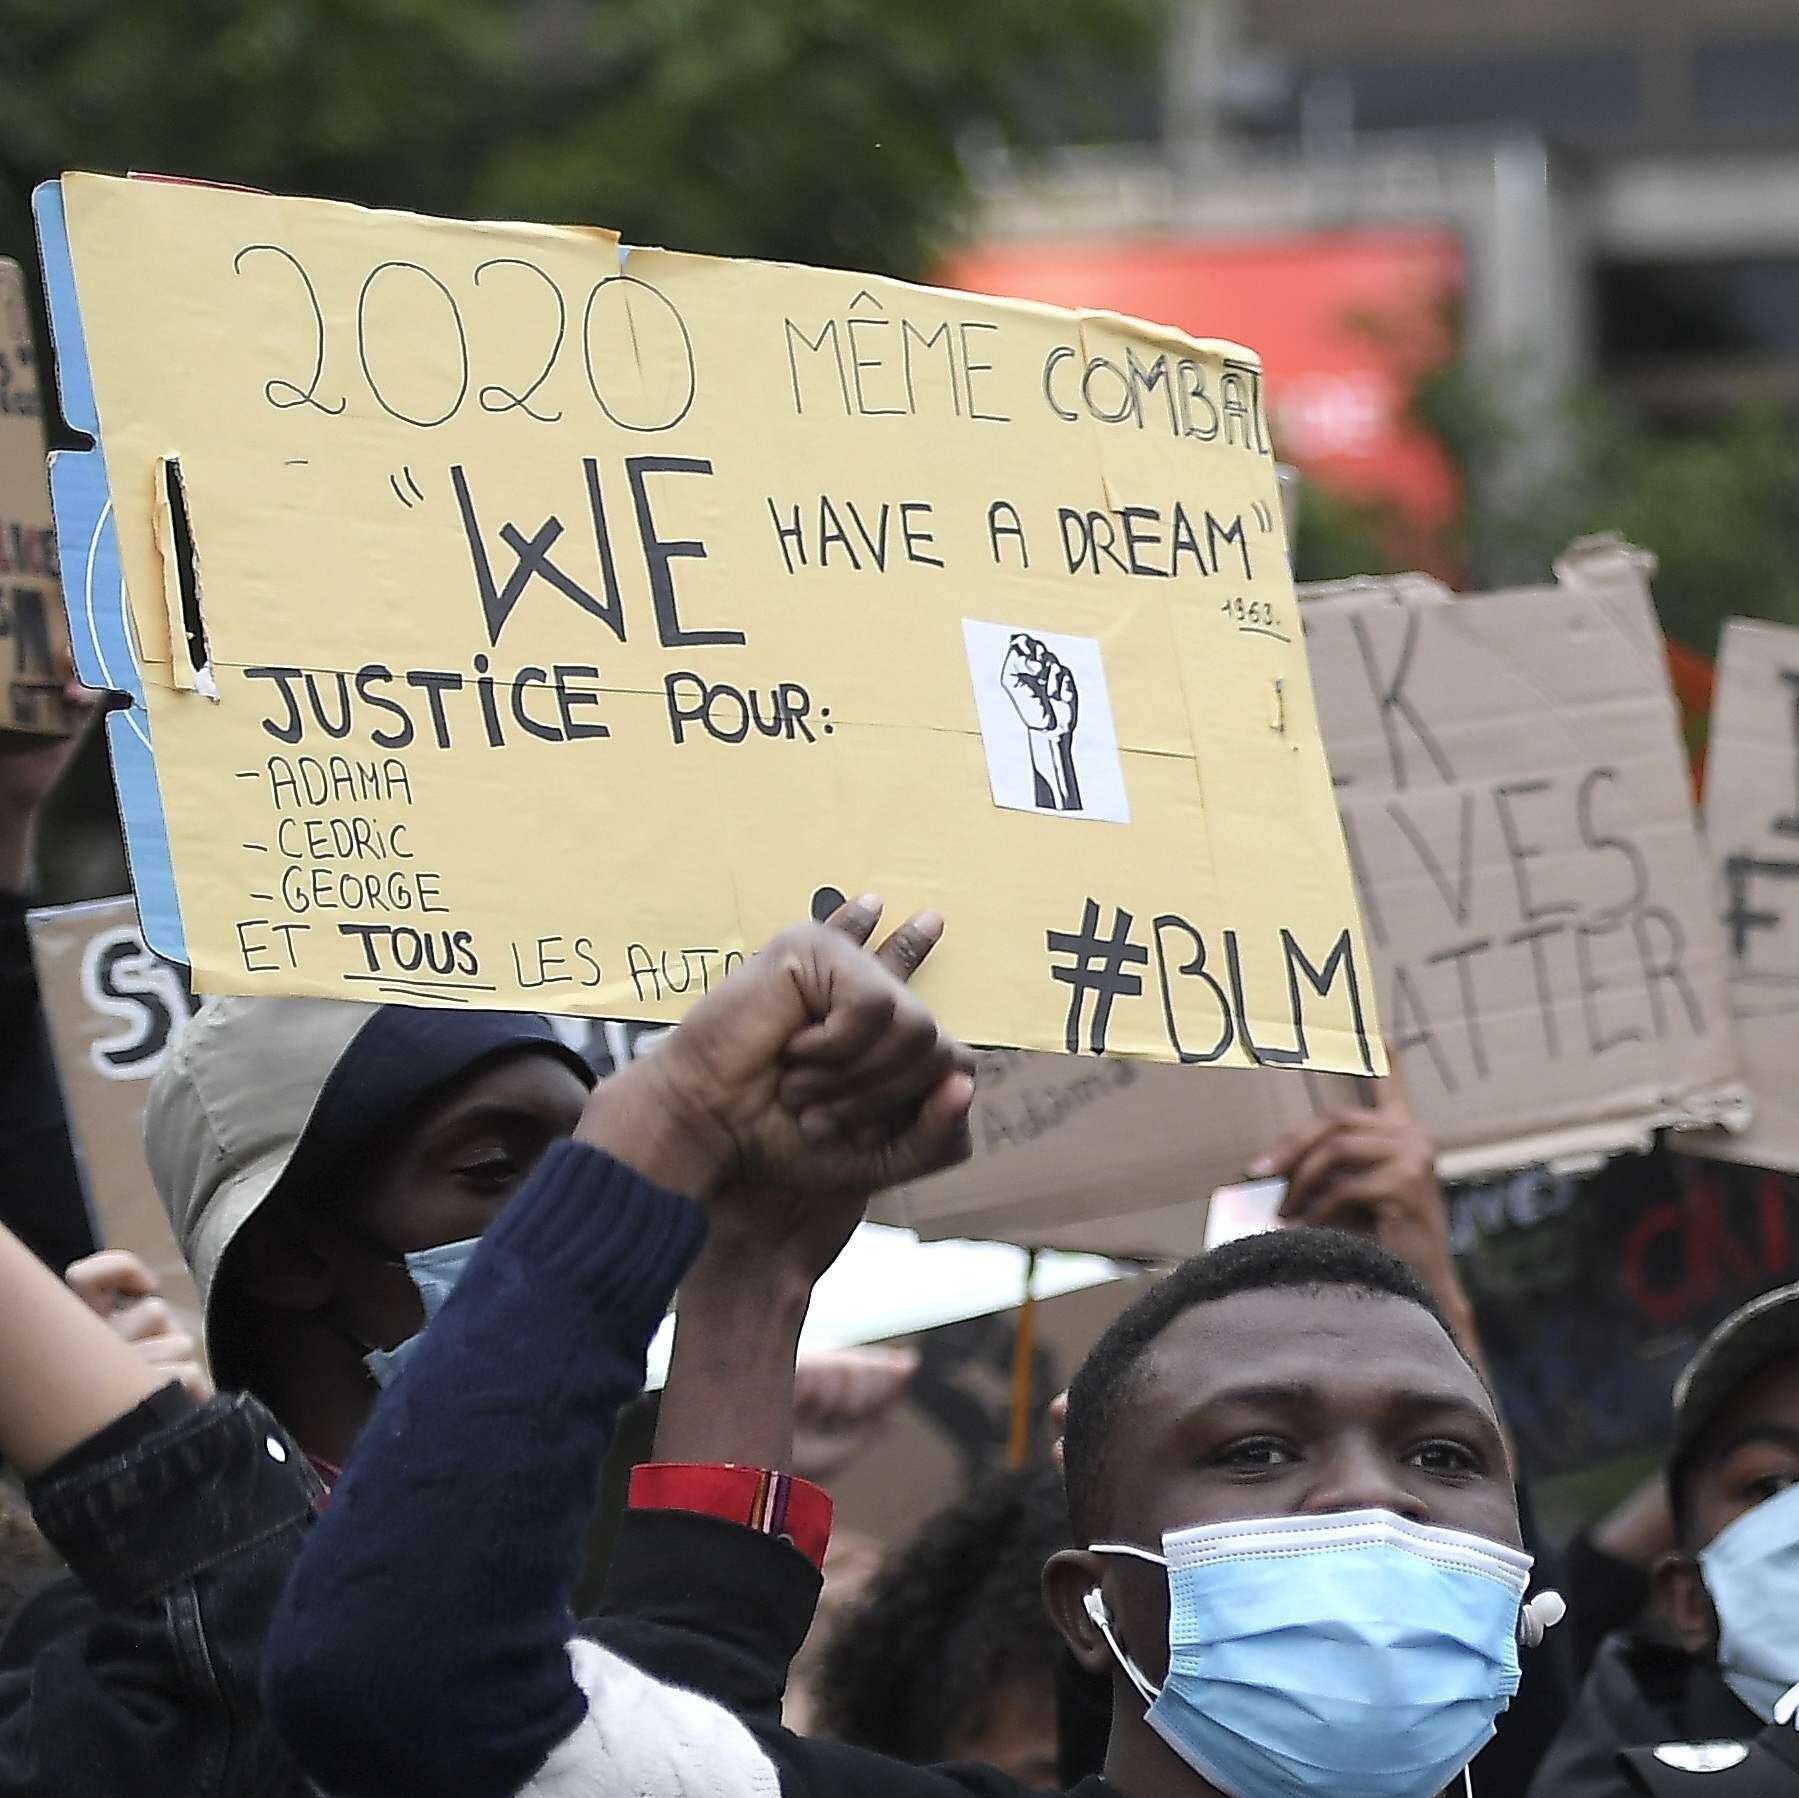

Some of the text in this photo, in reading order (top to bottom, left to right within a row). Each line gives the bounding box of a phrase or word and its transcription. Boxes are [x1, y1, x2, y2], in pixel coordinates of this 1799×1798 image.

[234, 243, 1269, 456] 2020 MÊME COMBAT
[766, 494, 945, 575] HAVE
[985, 498, 1030, 570] A
[666, 671, 837, 745] POUR:
[1340, 765, 1651, 952] IVES
[236, 919, 312, 976] ET
[339, 920, 482, 979] TOUS
[511, 936, 602, 989] LES
[1045, 895, 1381, 1078] #BLM
[1303, 903, 1710, 1110] ATTER
